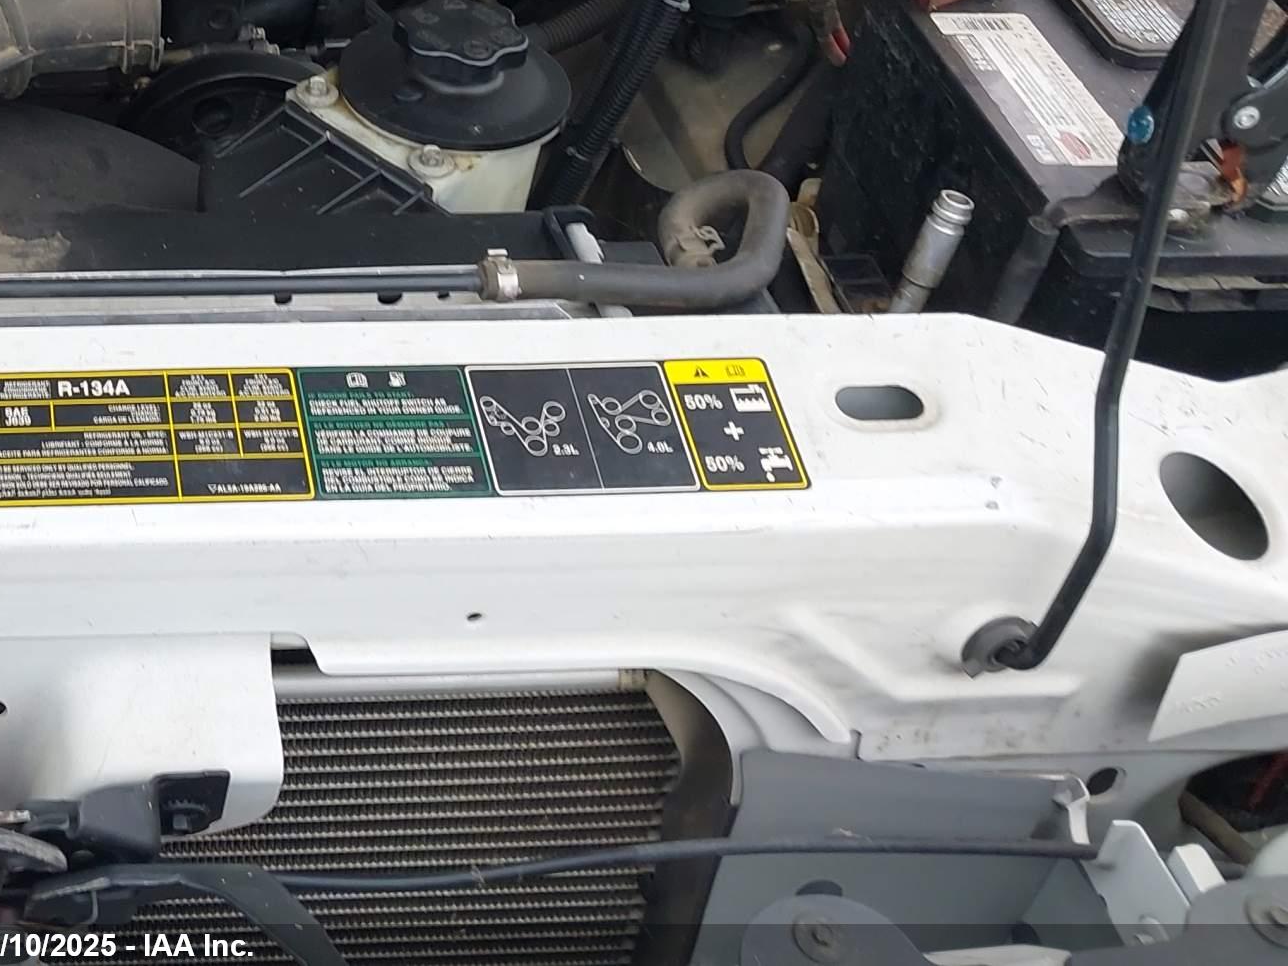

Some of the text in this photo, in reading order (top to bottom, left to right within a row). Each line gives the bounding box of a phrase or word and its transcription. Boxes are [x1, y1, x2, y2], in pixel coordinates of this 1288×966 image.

[57, 378, 130, 397] R-134A
[684, 393, 723, 411] 50%
[552, 444, 580, 456] 2.3L
[647, 441, 674, 454] 4.0L
[704, 455, 745, 473] 50%
